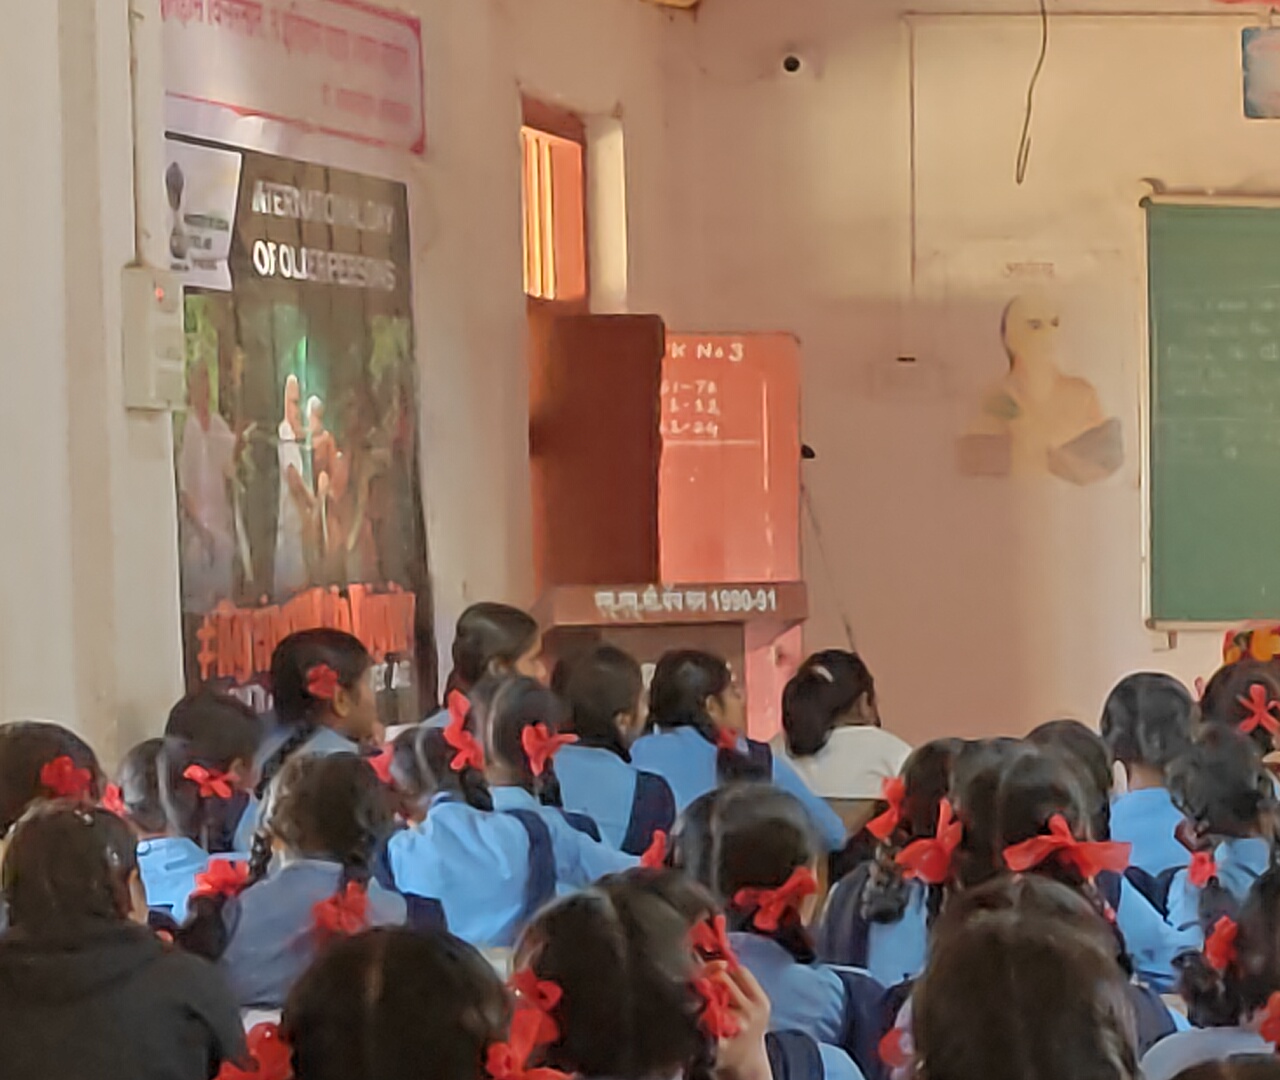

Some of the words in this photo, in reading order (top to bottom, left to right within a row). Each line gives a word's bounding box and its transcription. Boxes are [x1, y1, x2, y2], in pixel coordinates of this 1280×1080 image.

[696, 341, 725, 360] No
[728, 341, 745, 363] 3
[710, 587, 777, 612] 1990-91
